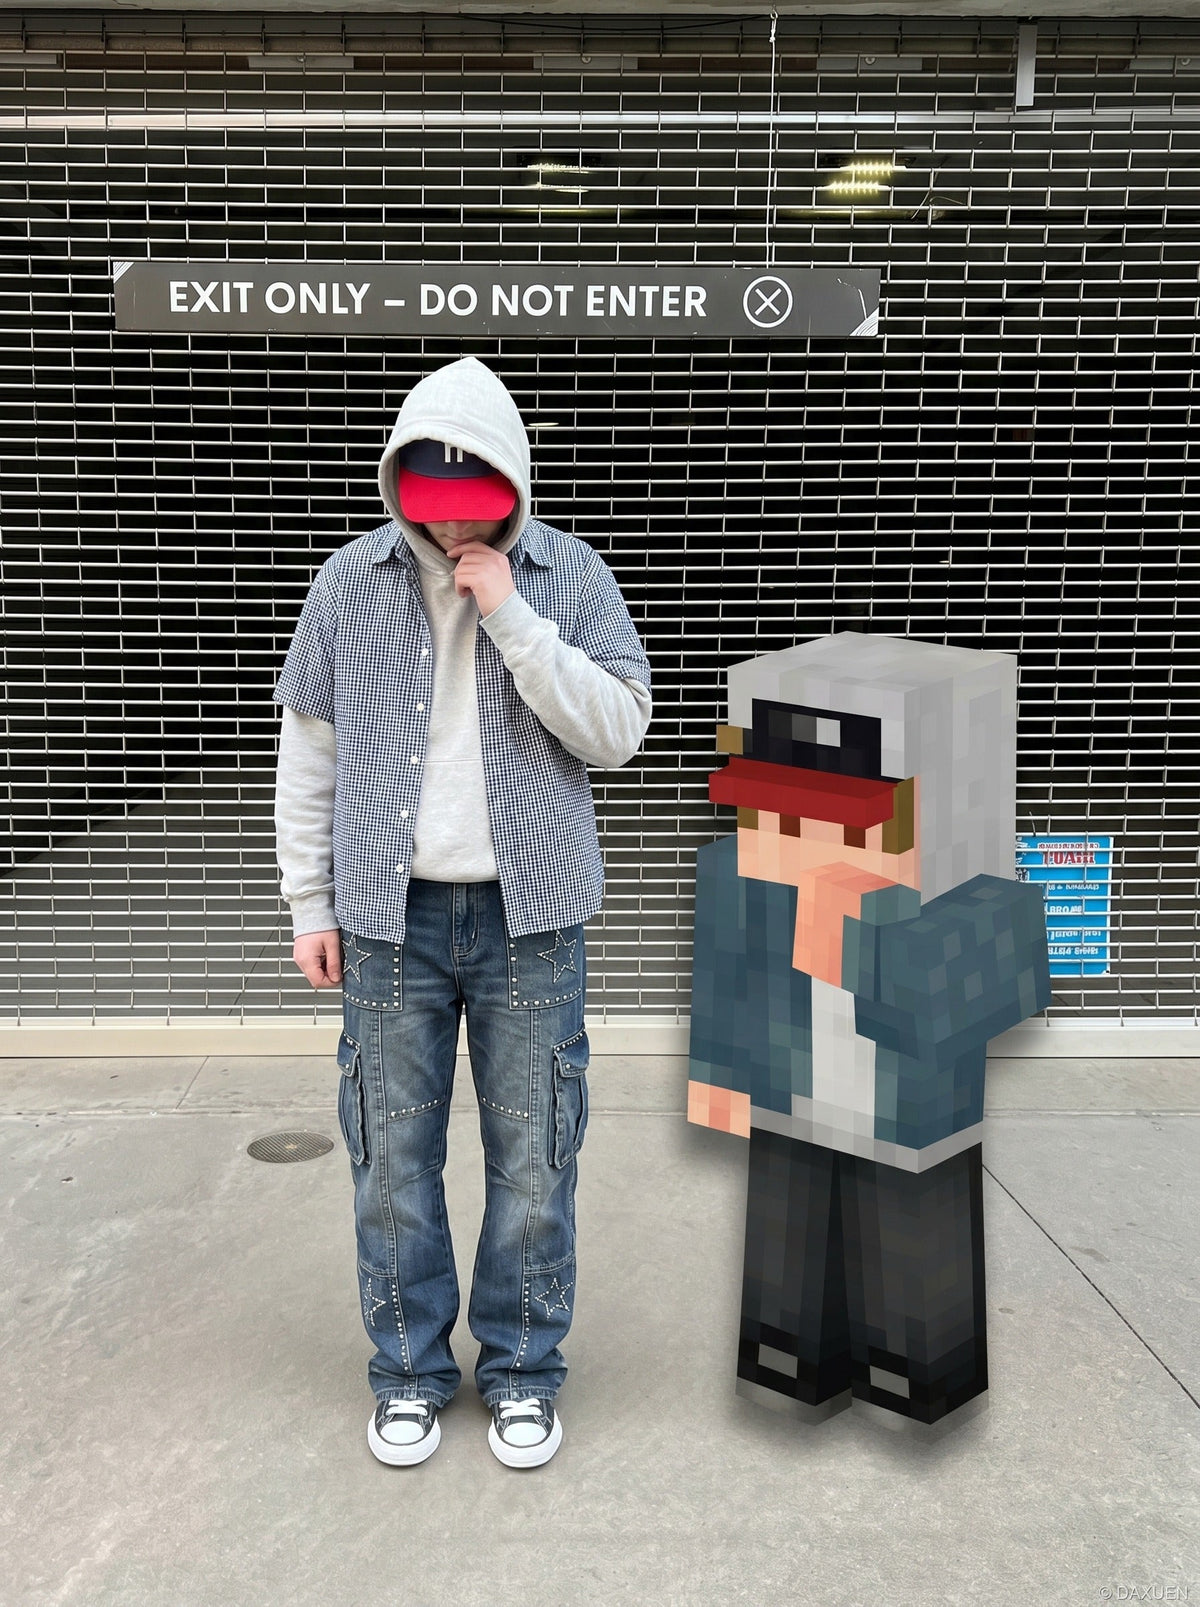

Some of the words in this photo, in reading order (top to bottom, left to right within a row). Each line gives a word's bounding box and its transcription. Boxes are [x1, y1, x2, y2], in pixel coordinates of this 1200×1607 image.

[168, 280, 255, 314] EXIT
[264, 281, 372, 316] ONLY
[419, 283, 479, 317] DO
[490, 284, 575, 317] NOT
[585, 285, 708, 318] ENTER
